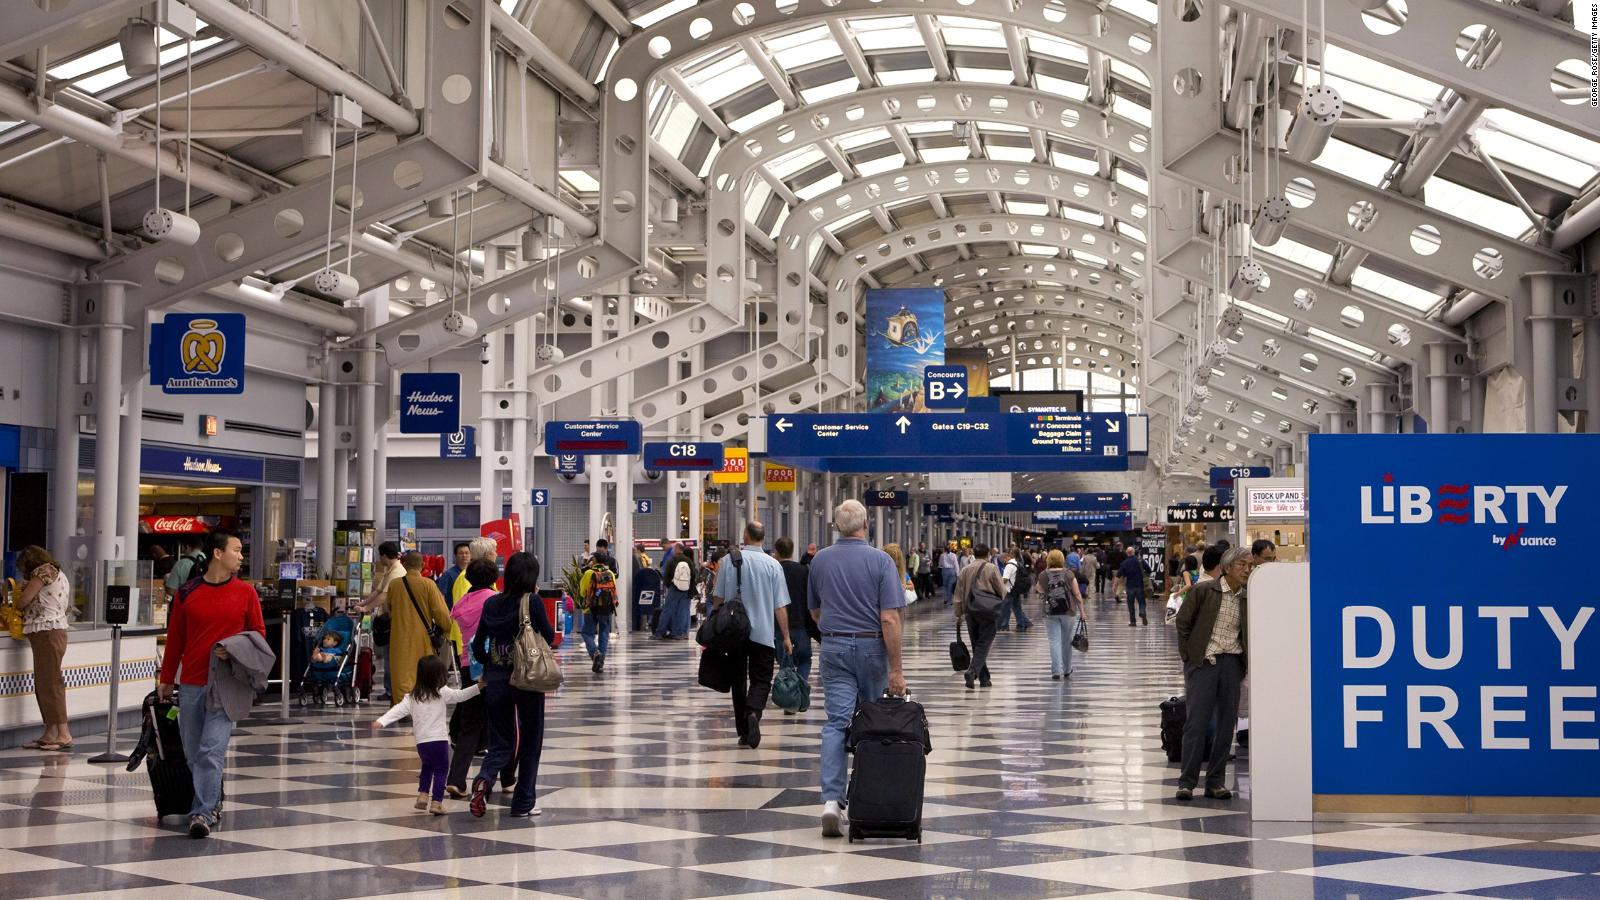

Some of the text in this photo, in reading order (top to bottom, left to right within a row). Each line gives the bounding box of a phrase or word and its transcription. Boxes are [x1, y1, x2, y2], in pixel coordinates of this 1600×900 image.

[406, 391, 454, 402] Hudson
[930, 382, 945, 400] B
[406, 404, 444, 415] News
[670, 445, 696, 456] C18
[184, 456, 206, 472] Hudson
[1230, 468, 1250, 478] C19
[536, 491, 544, 504] $
[878, 491, 895, 499] C20
[1253, 492, 1274, 500] STOCK
[1275, 492, 1284, 500] UP
[641, 502, 648, 512] $
[1220, 509, 1235, 519] CL
[1493, 534, 1506, 545] by
[1342, 605, 1595, 670] DUTY
[1343, 685, 1600, 750] FREE
